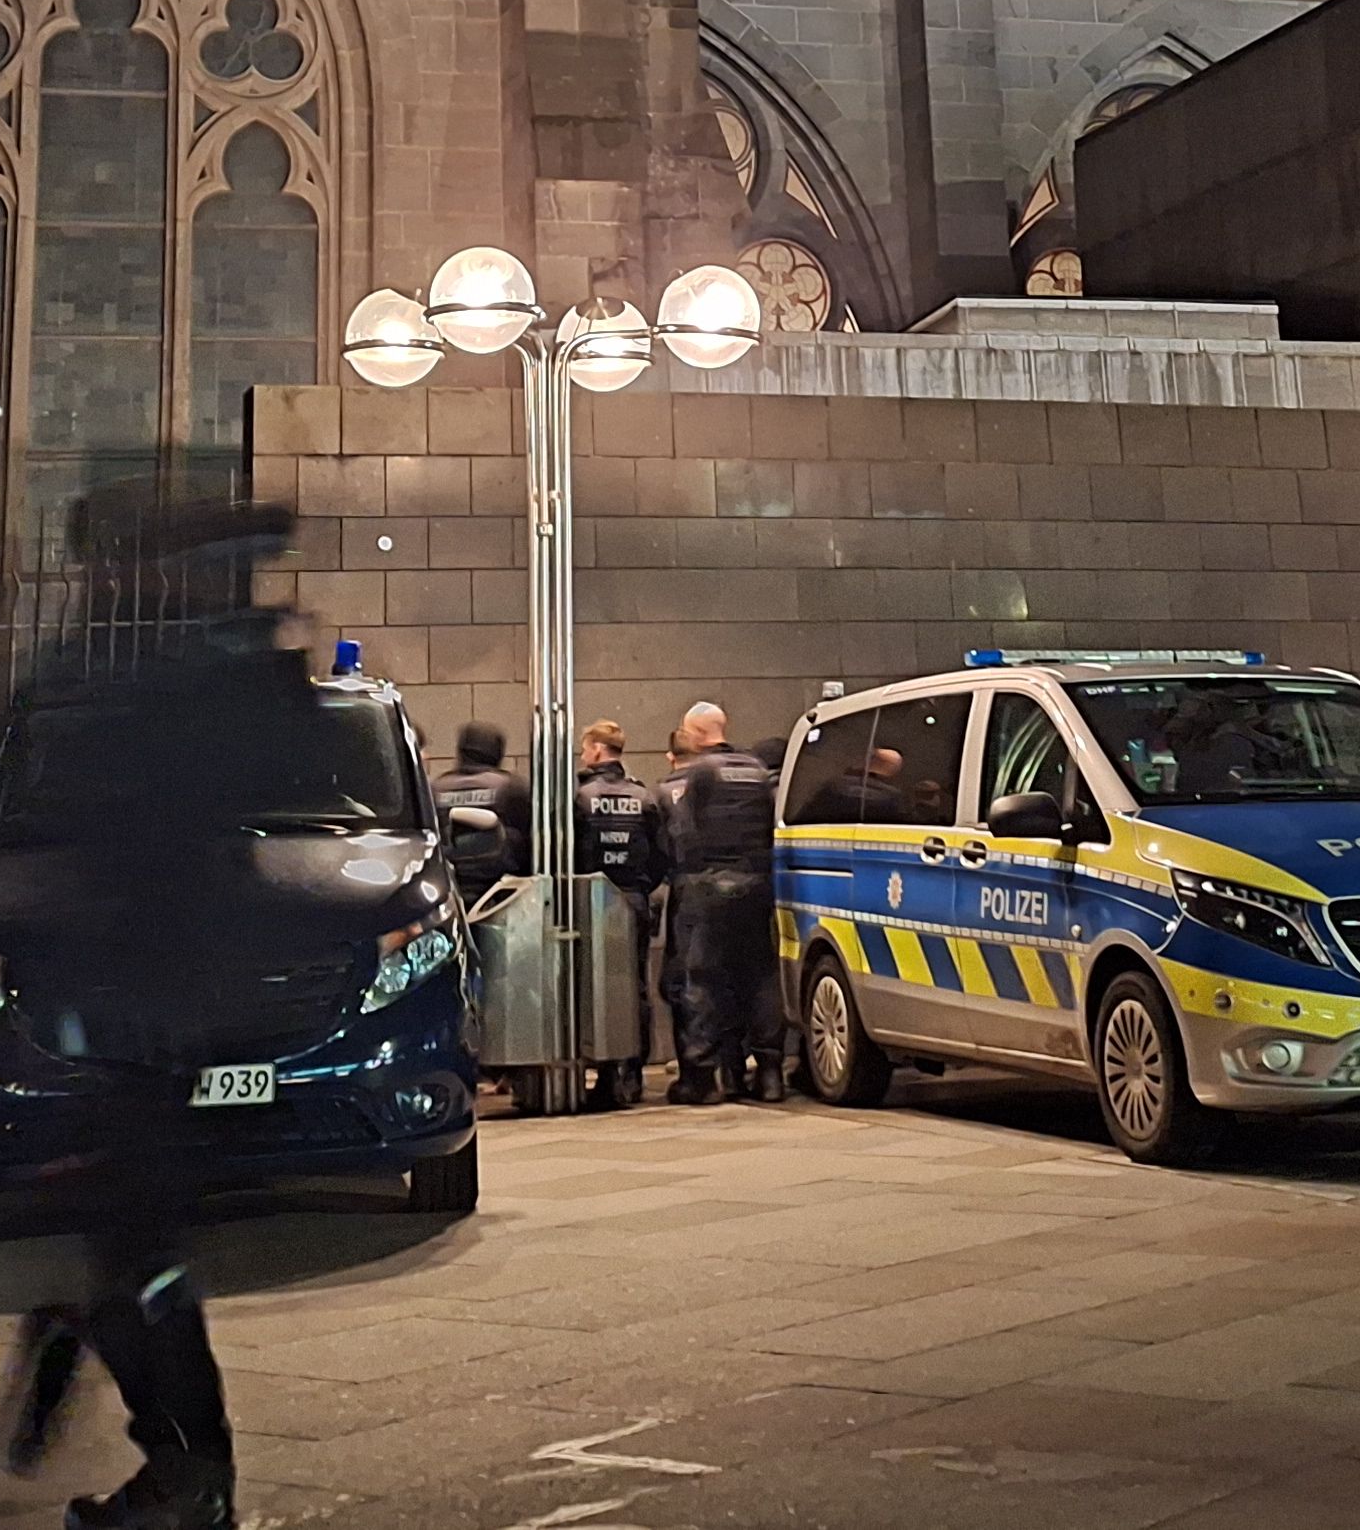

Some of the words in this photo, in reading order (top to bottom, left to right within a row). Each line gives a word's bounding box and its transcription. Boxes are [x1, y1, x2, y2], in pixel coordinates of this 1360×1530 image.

[590, 797, 642, 815] POLIZEI
[980, 886, 1049, 925] POLIZEI
[219, 1069, 270, 1100] 939
